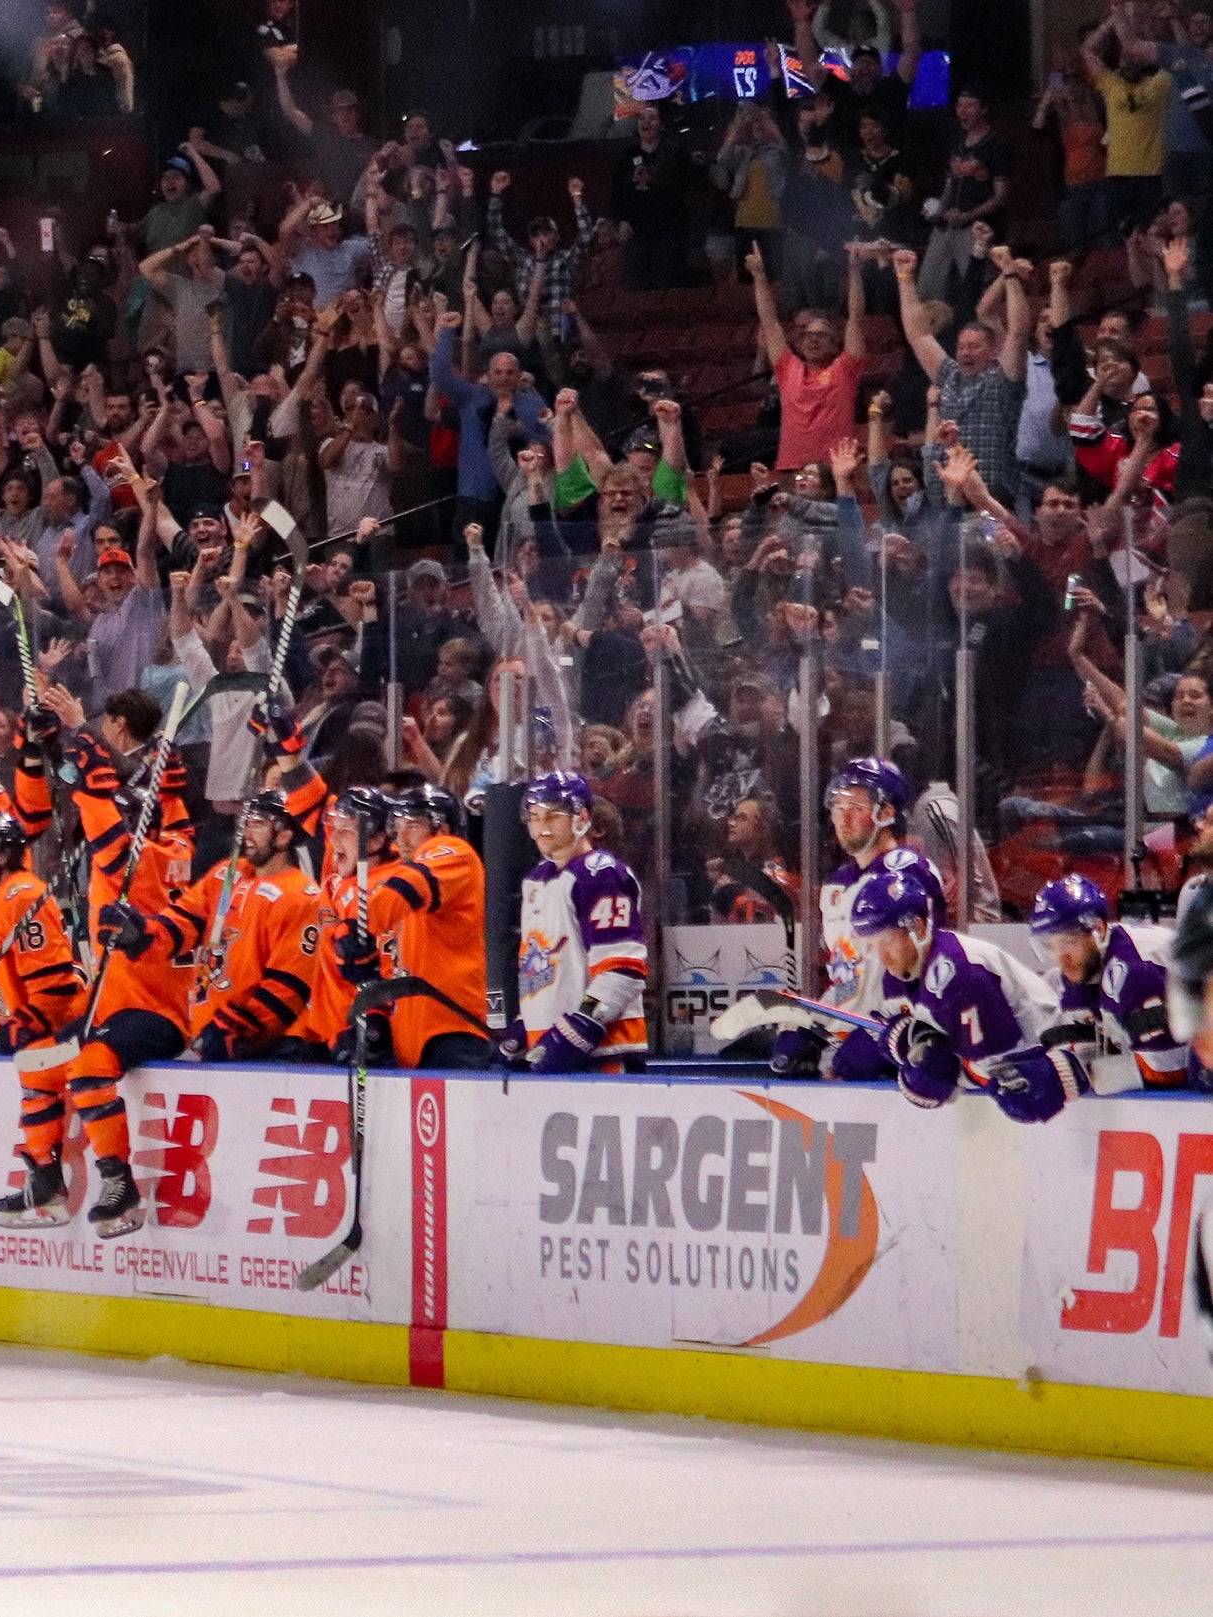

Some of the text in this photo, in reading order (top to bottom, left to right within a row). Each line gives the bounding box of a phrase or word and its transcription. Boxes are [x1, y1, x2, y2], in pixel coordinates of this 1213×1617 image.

[590, 896, 632, 930] 43
[539, 1112, 878, 1239] SARGENT
[114, 1246, 230, 1285] GREENVILLE
[540, 1236, 799, 1293] PEST SOLUTIONS
